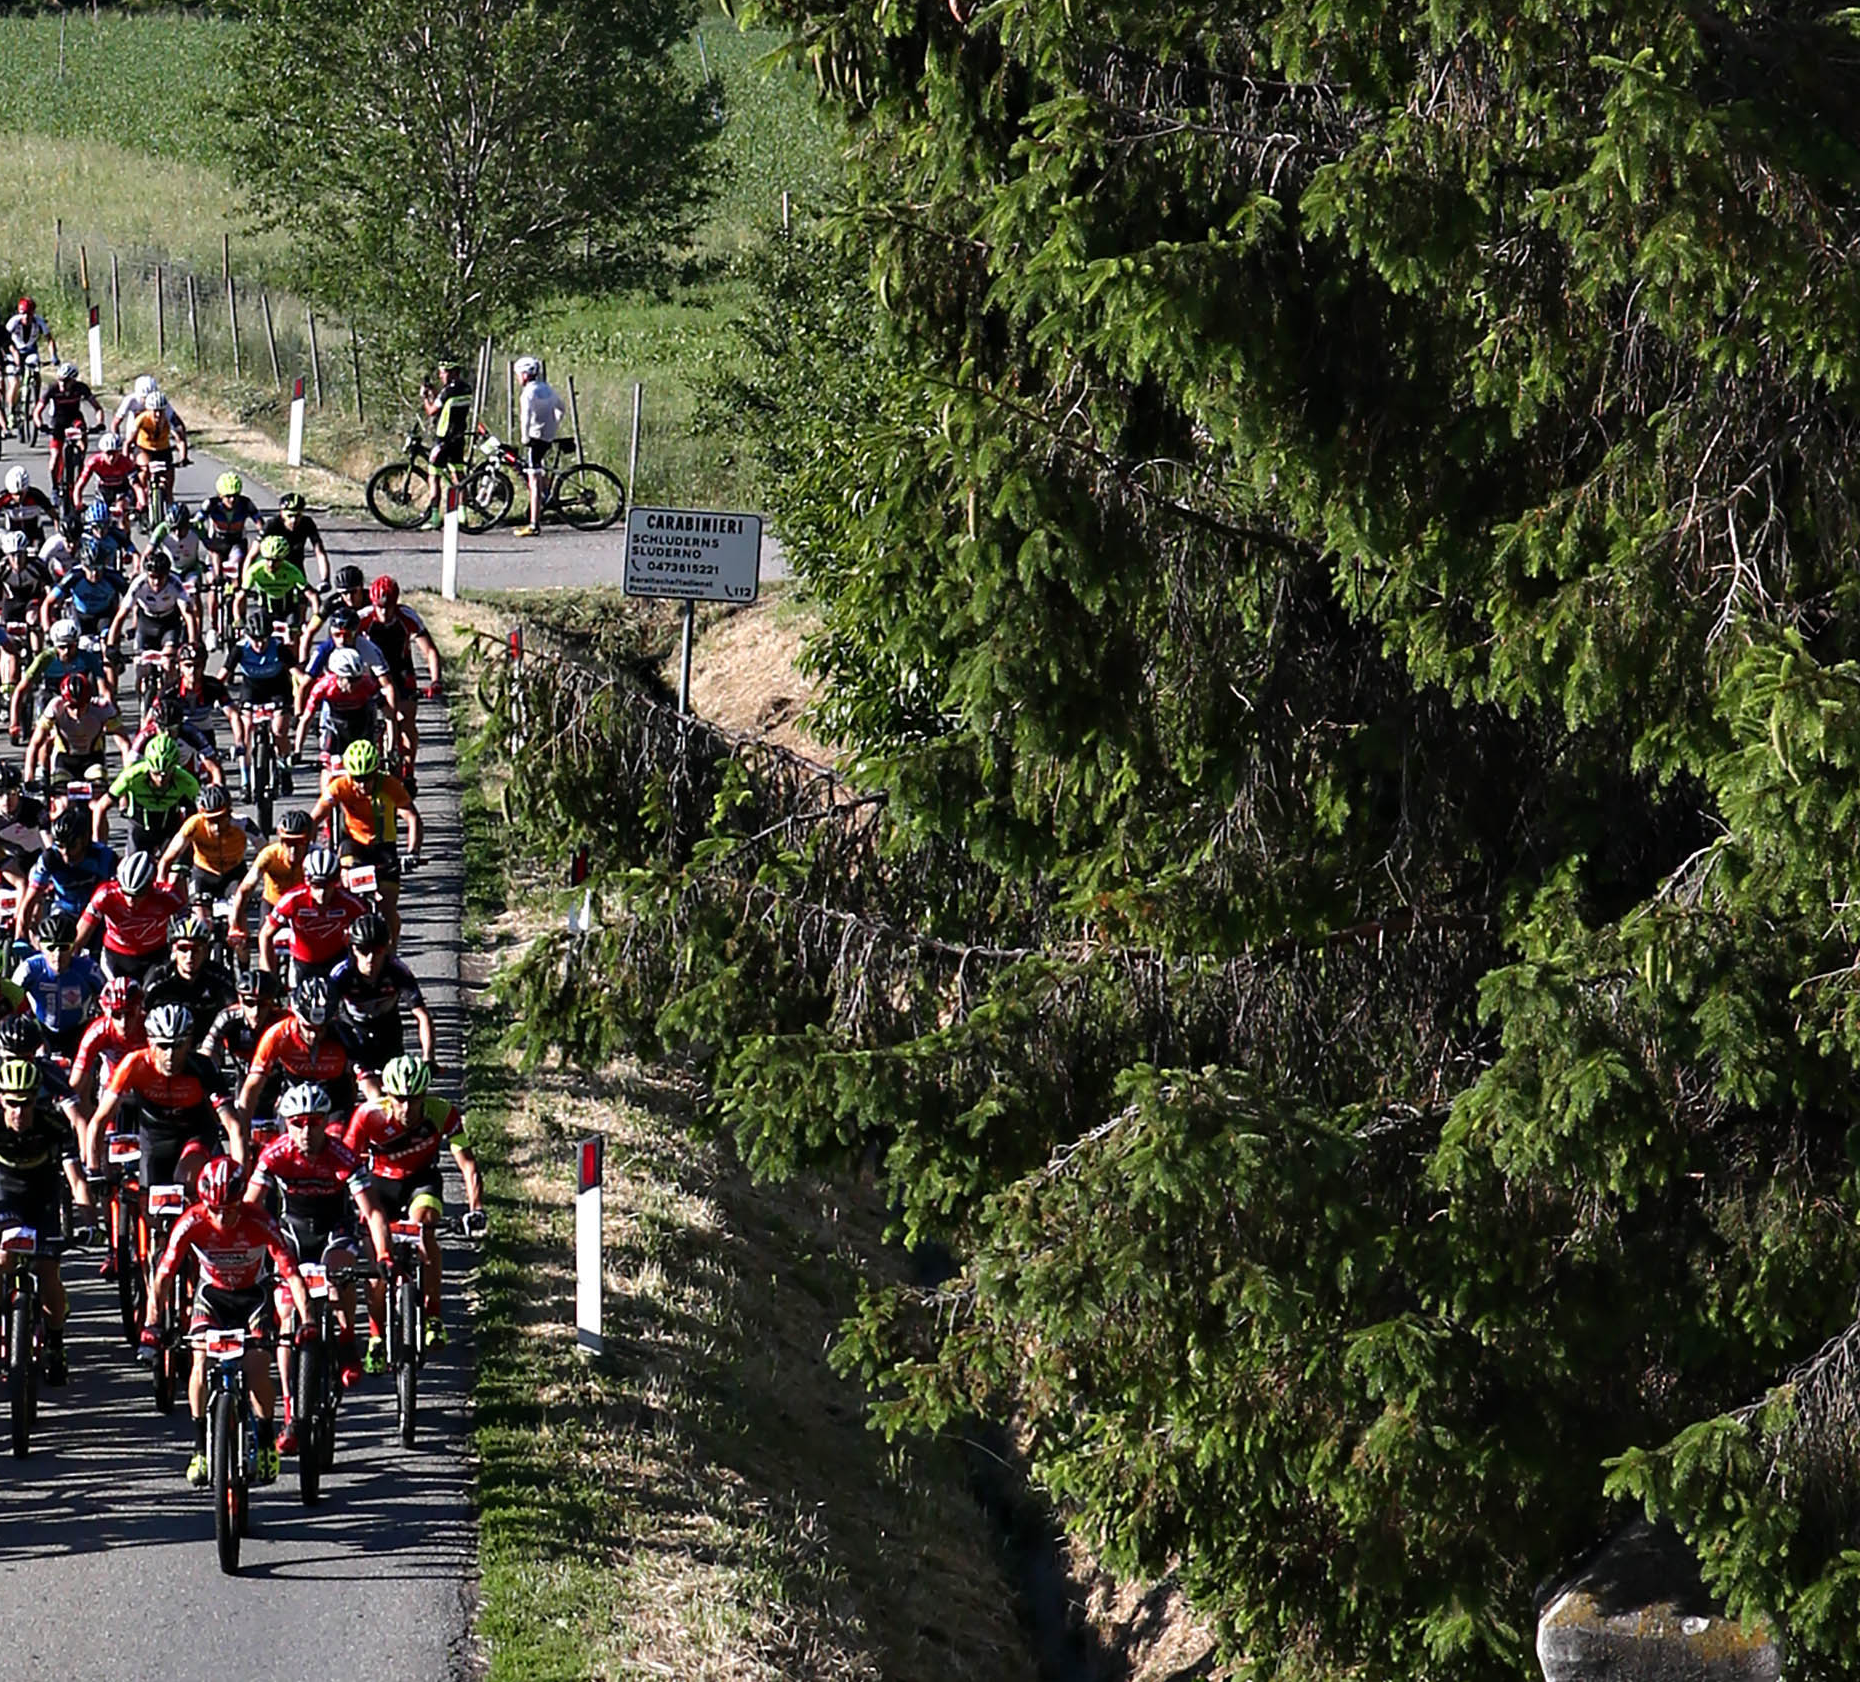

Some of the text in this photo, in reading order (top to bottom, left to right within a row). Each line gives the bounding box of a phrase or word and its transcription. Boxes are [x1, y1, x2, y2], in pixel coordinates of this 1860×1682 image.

[647, 514, 743, 534] CARABINIERI
[632, 533, 720, 549] SCHLUDERNS
[631, 545, 702, 559] SLUDERNO
[734, 587, 752, 597] 112
